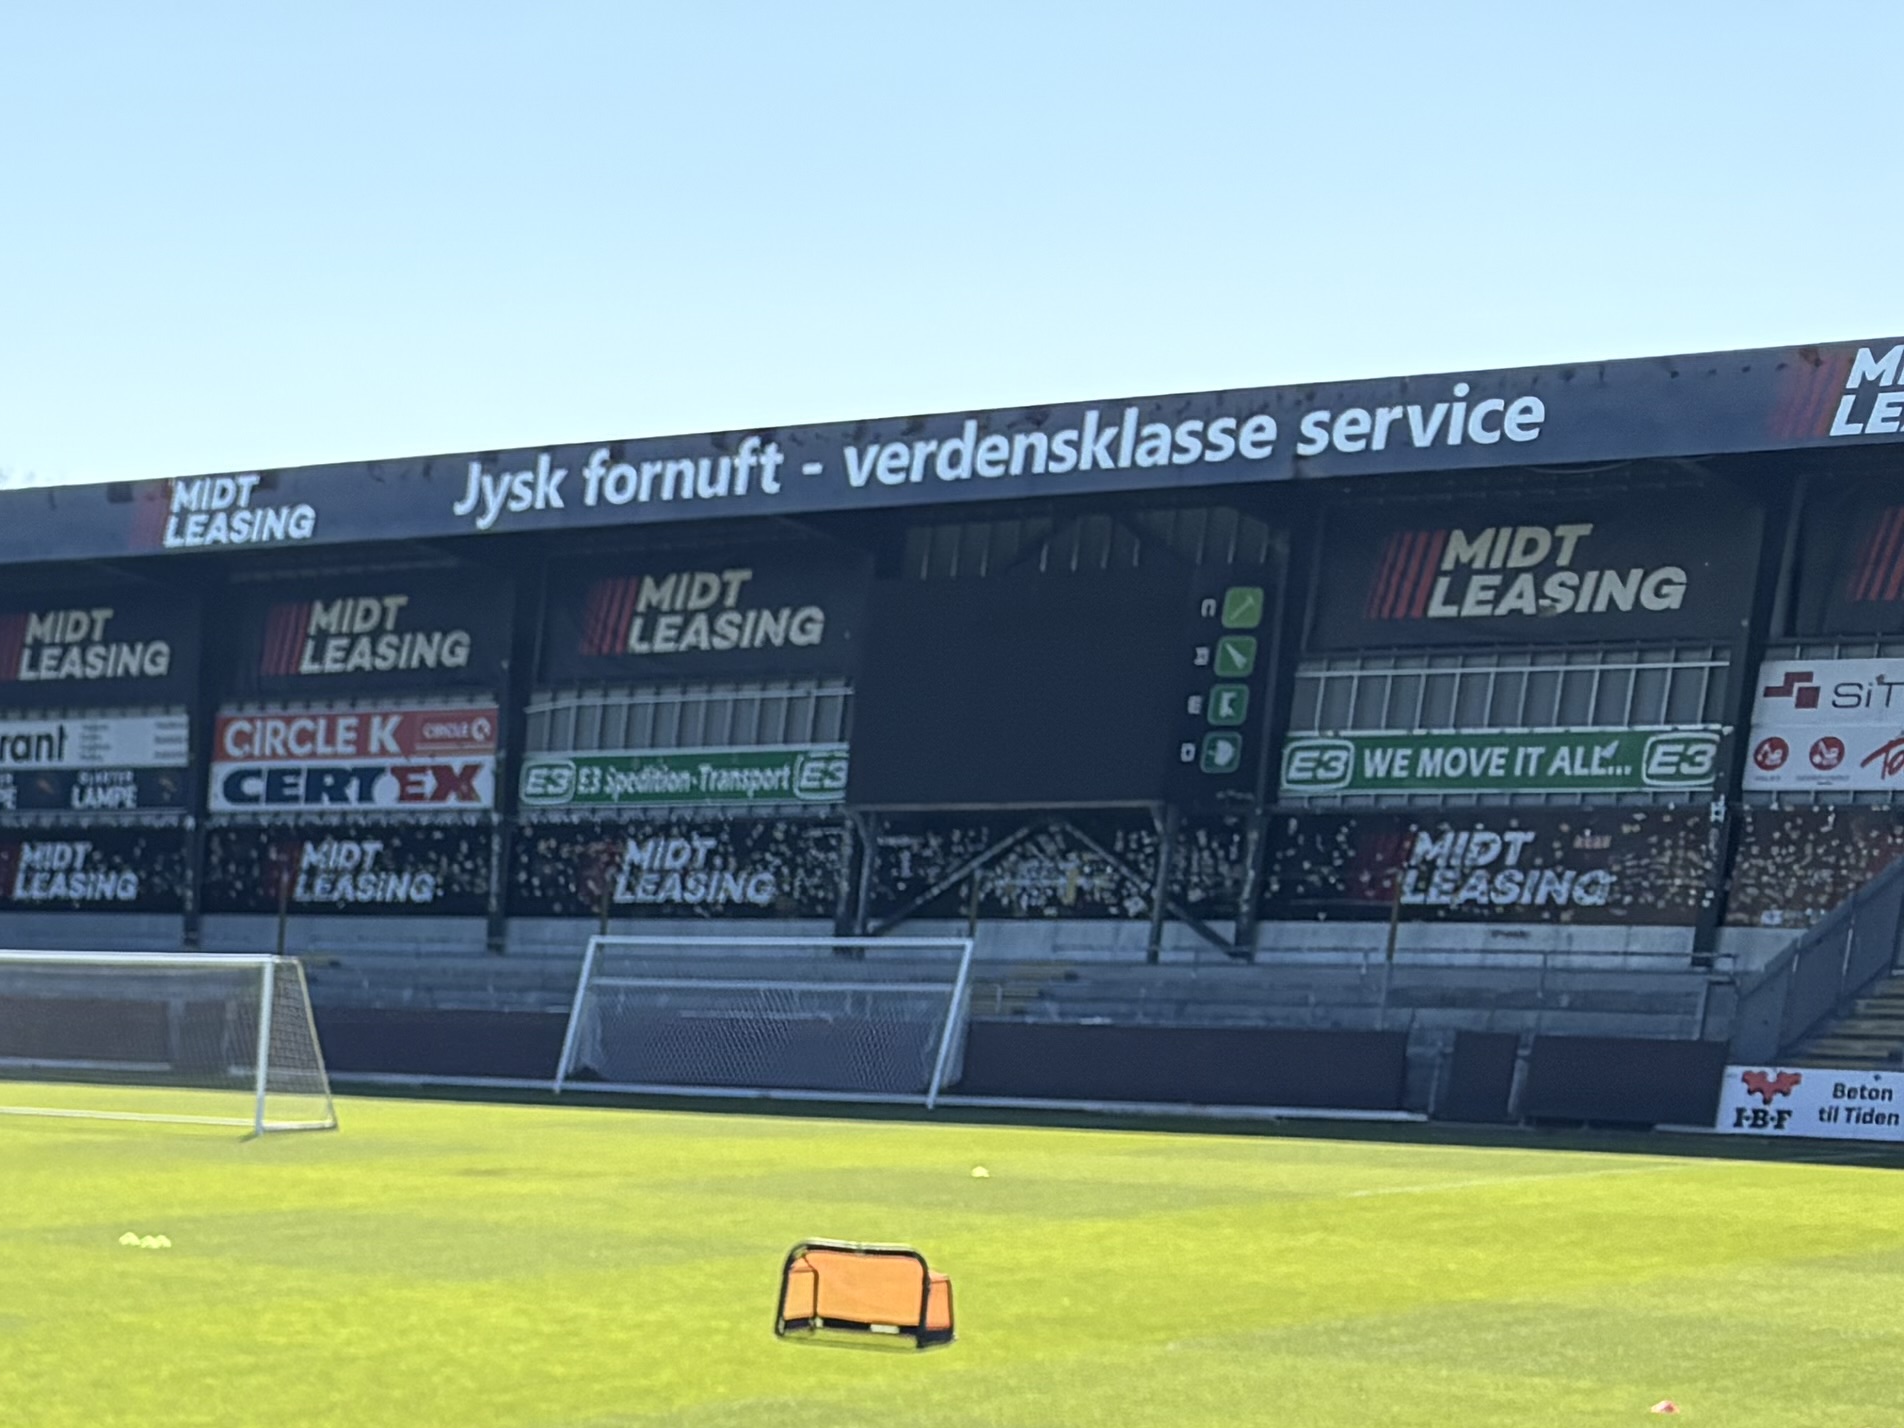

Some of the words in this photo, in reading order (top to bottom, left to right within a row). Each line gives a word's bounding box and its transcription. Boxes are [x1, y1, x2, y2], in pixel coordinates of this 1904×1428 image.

[453, 453, 568, 530] Jysk
[583, 436, 783, 505] fornuft
[845, 408, 1277, 487] verdensklasse
[1297, 383, 1545, 456] service
[171, 475, 259, 512] MIDT
[164, 504, 314, 549] LEASING
[1442, 523, 1592, 571] MIDT
[637, 569, 752, 609] MIDT
[1427, 566, 1687, 617] LEASING
[25, 609, 112, 644] MIDT
[309, 596, 408, 634] MIDT
[629, 606, 825, 653] LEASING
[19, 641, 170, 680] LEASING
[301, 630, 471, 675] LEASING
[224, 716, 357, 757] CIRCLE
[369, 715, 403, 755] K
[525, 768, 572, 795] E3
[799, 759, 847, 788] E3
[1287, 749, 1349, 779] E3
[1364, 748, 1409, 778] WE
[1417, 747, 1504, 778] MOVE
[1514, 747, 1545, 776] IT
[1648, 744, 1717, 774] E3
[223, 764, 483, 805] CERTEX
[21, 841, 92, 869] MIDT
[302, 840, 383, 870] MIDT
[624, 836, 716, 870] MIDT
[1410, 831, 1535, 867] MIDT
[14, 871, 138, 900] LEASING
[295, 872, 436, 903] LEASING
[614, 872, 776, 905] LEASING
[1400, 868, 1616, 904] LEASING
[1833, 1083, 1893, 1102] Beton
[1819, 1106, 1838, 1123] til
[1845, 1107, 1899, 1125] Tiden
